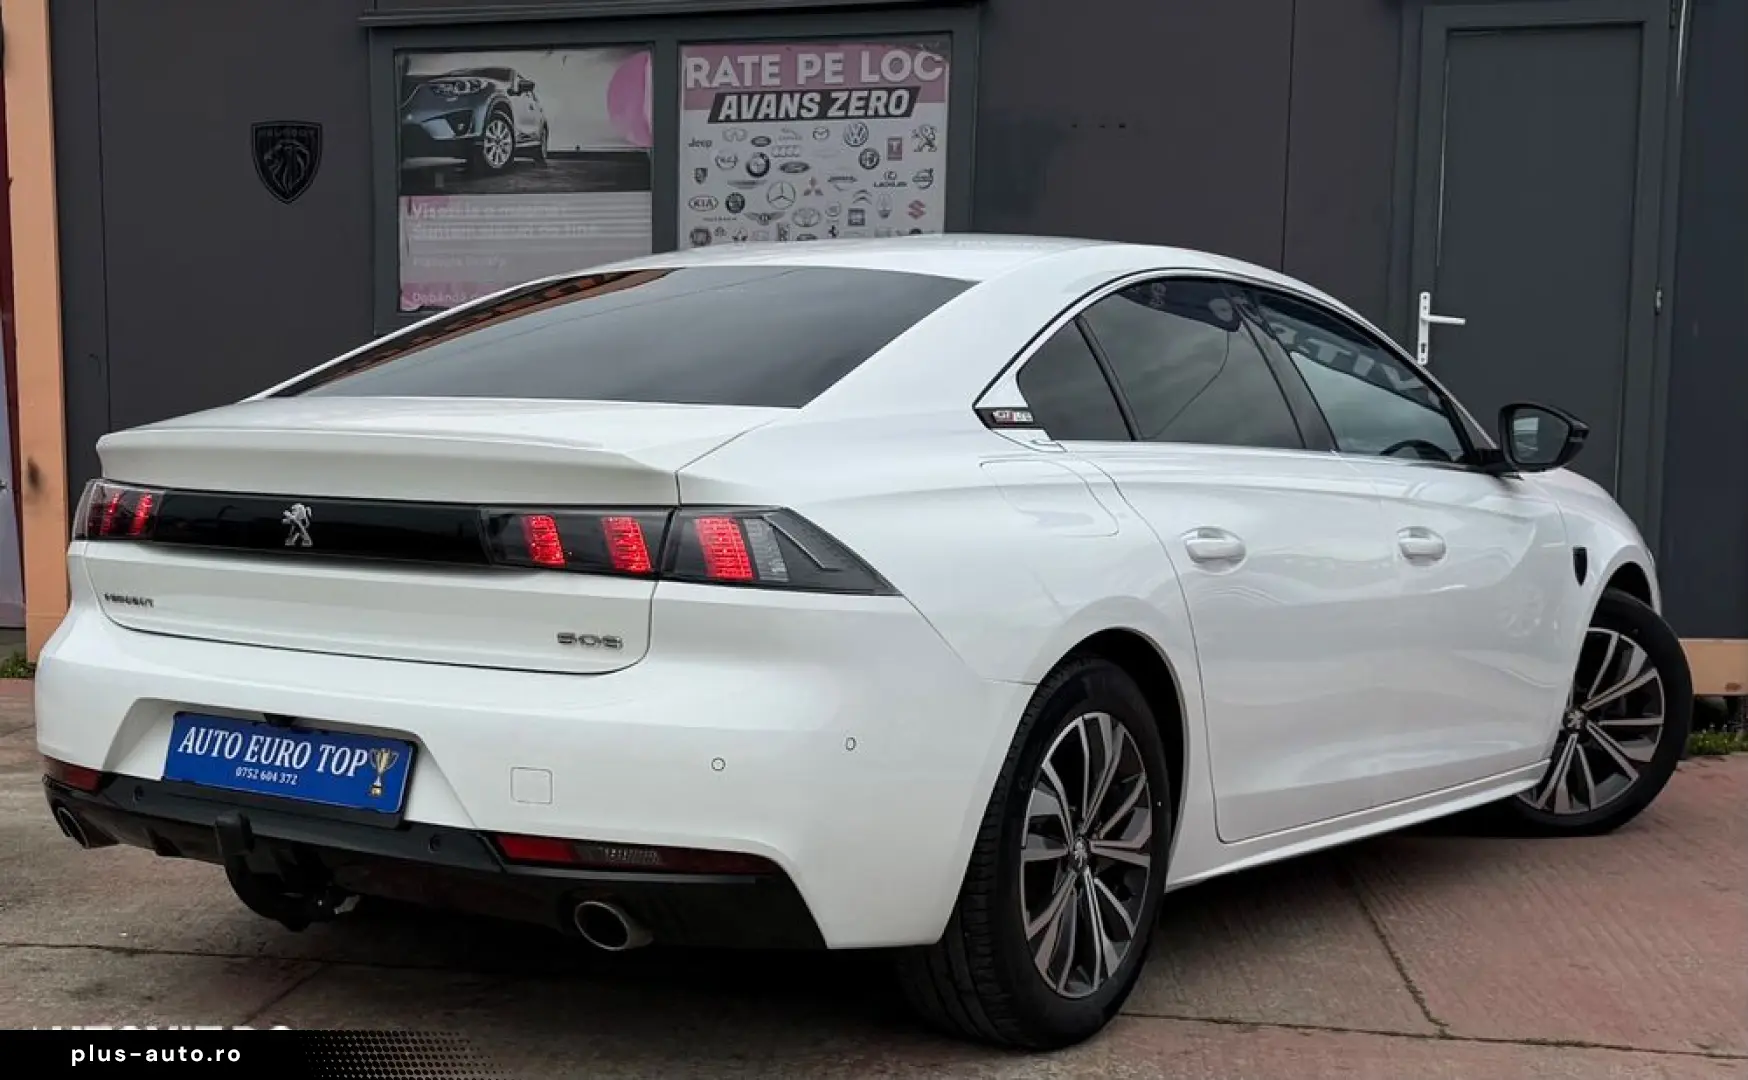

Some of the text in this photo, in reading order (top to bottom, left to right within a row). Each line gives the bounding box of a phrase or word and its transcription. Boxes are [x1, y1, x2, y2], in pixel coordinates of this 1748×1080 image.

[686, 50, 943, 88] RATE PE LOC
[719, 89, 910, 120] AVANS ZERO
[177, 726, 368, 777] AUTO EURO TOP
[235, 766, 260, 778] 0752
[279, 772, 298, 785] 372
